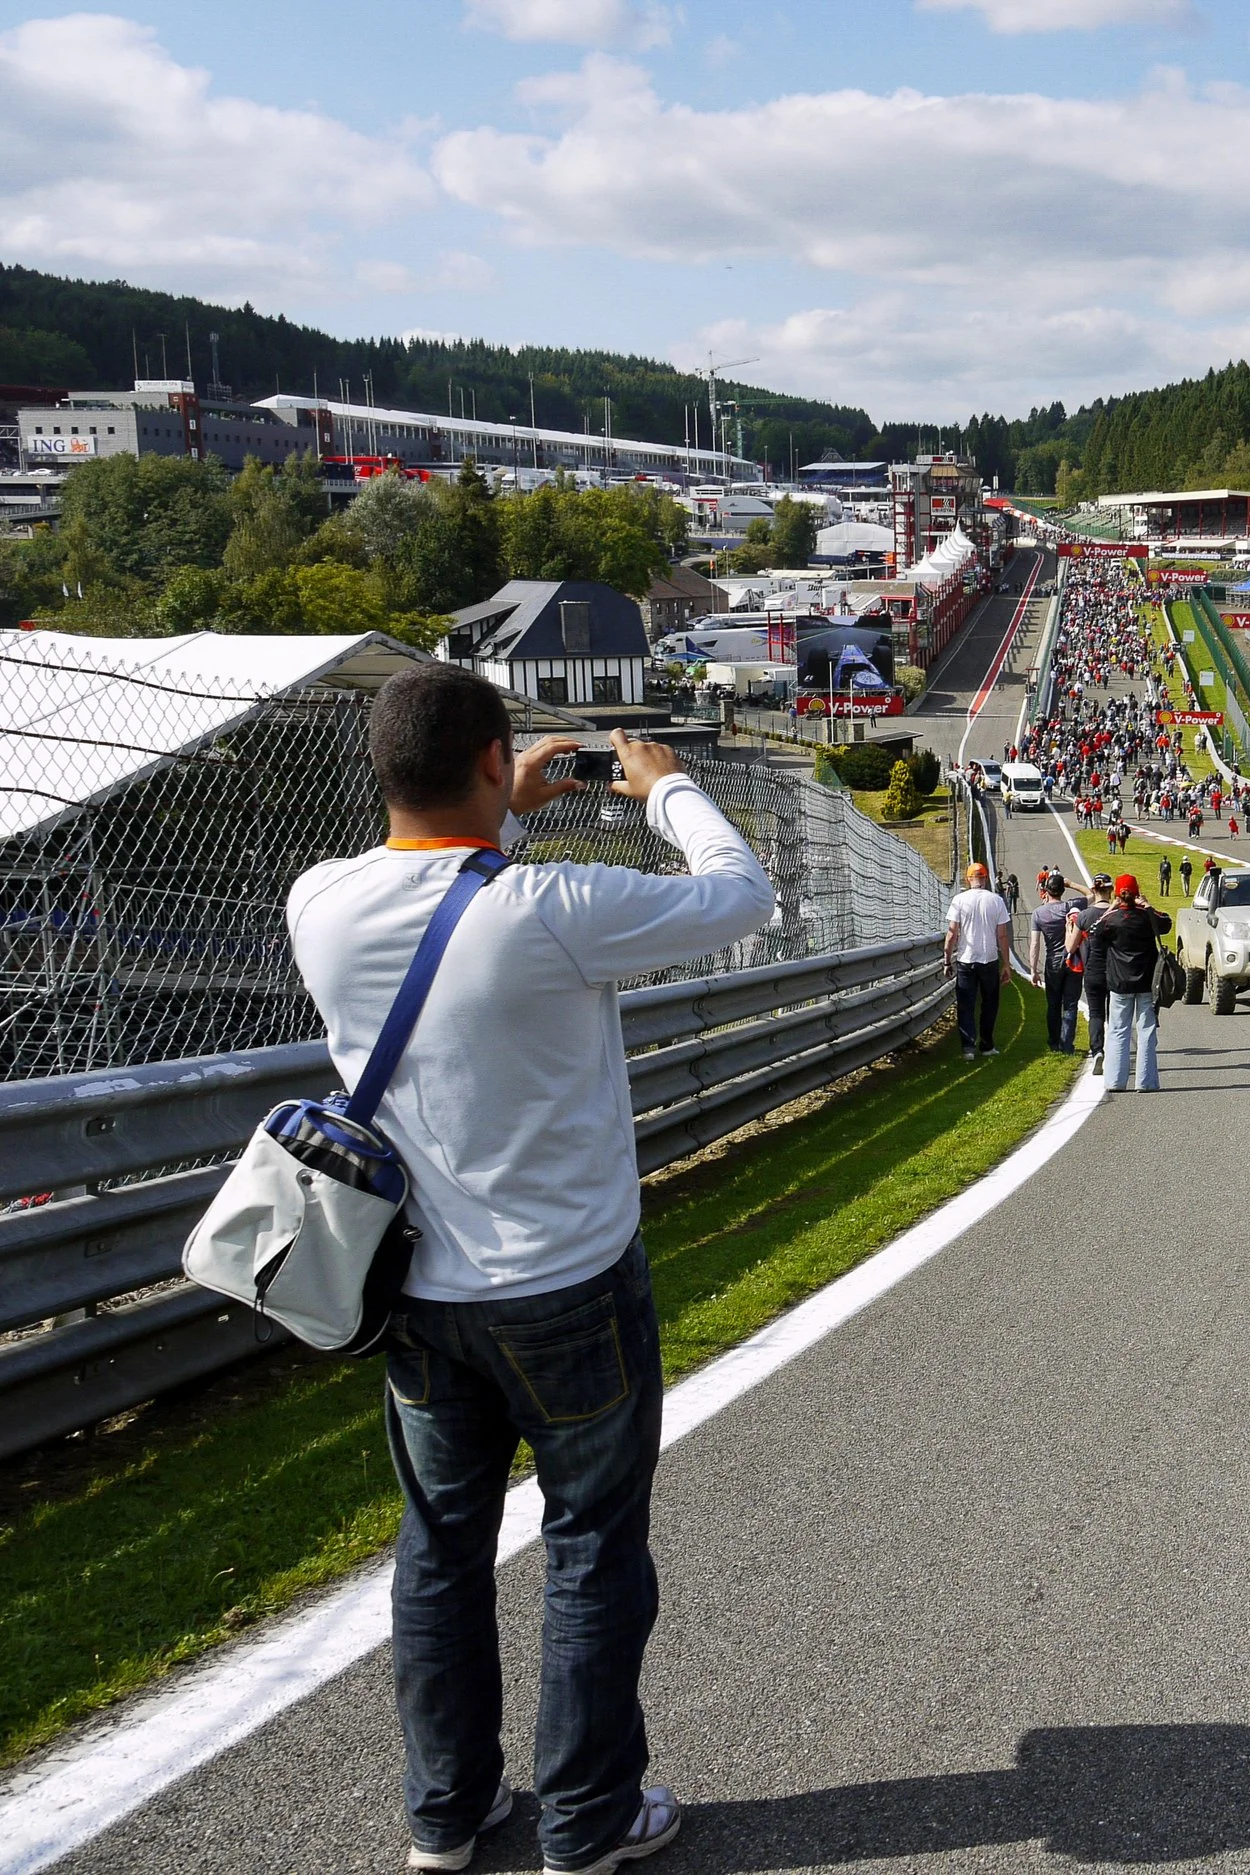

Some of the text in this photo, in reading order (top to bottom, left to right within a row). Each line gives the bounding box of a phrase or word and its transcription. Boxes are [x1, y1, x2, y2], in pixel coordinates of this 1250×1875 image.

[33, 439, 66, 453] ING
[1083, 547, 1128, 557] V-Power
[1160, 572, 1206, 582] V-Power
[1174, 715, 1219, 725] V-Power
